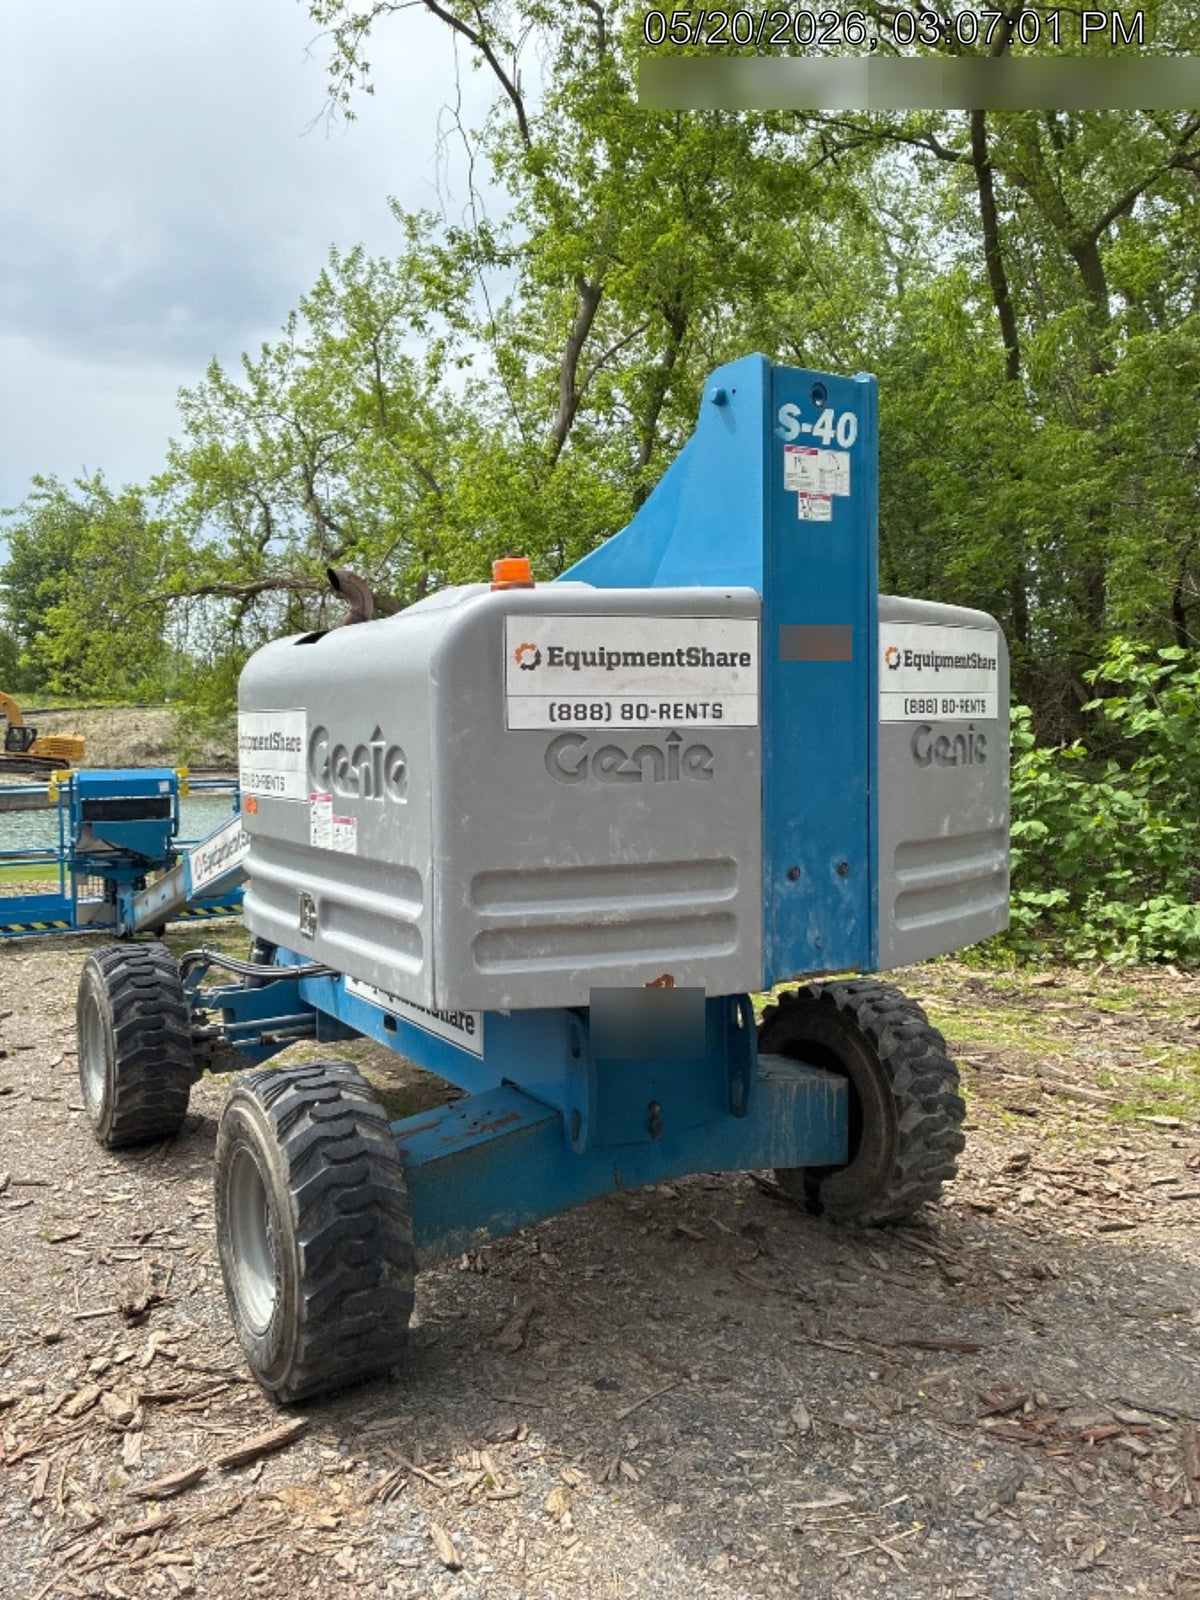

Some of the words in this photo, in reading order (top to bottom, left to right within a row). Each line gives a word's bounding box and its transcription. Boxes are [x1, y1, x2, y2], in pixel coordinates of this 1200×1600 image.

[775, 403, 858, 448] S-40
[547, 646, 751, 671] EquipmentShare
[903, 649, 997, 672] EquipmentShare
[549, 702, 612, 722] (888)
[621, 703, 723, 720] 80-RENTS
[904, 698, 938, 714] (888)
[544, 730, 714, 785] Genie
[911, 723, 987, 768] Genie
[309, 723, 408, 804] Genie
